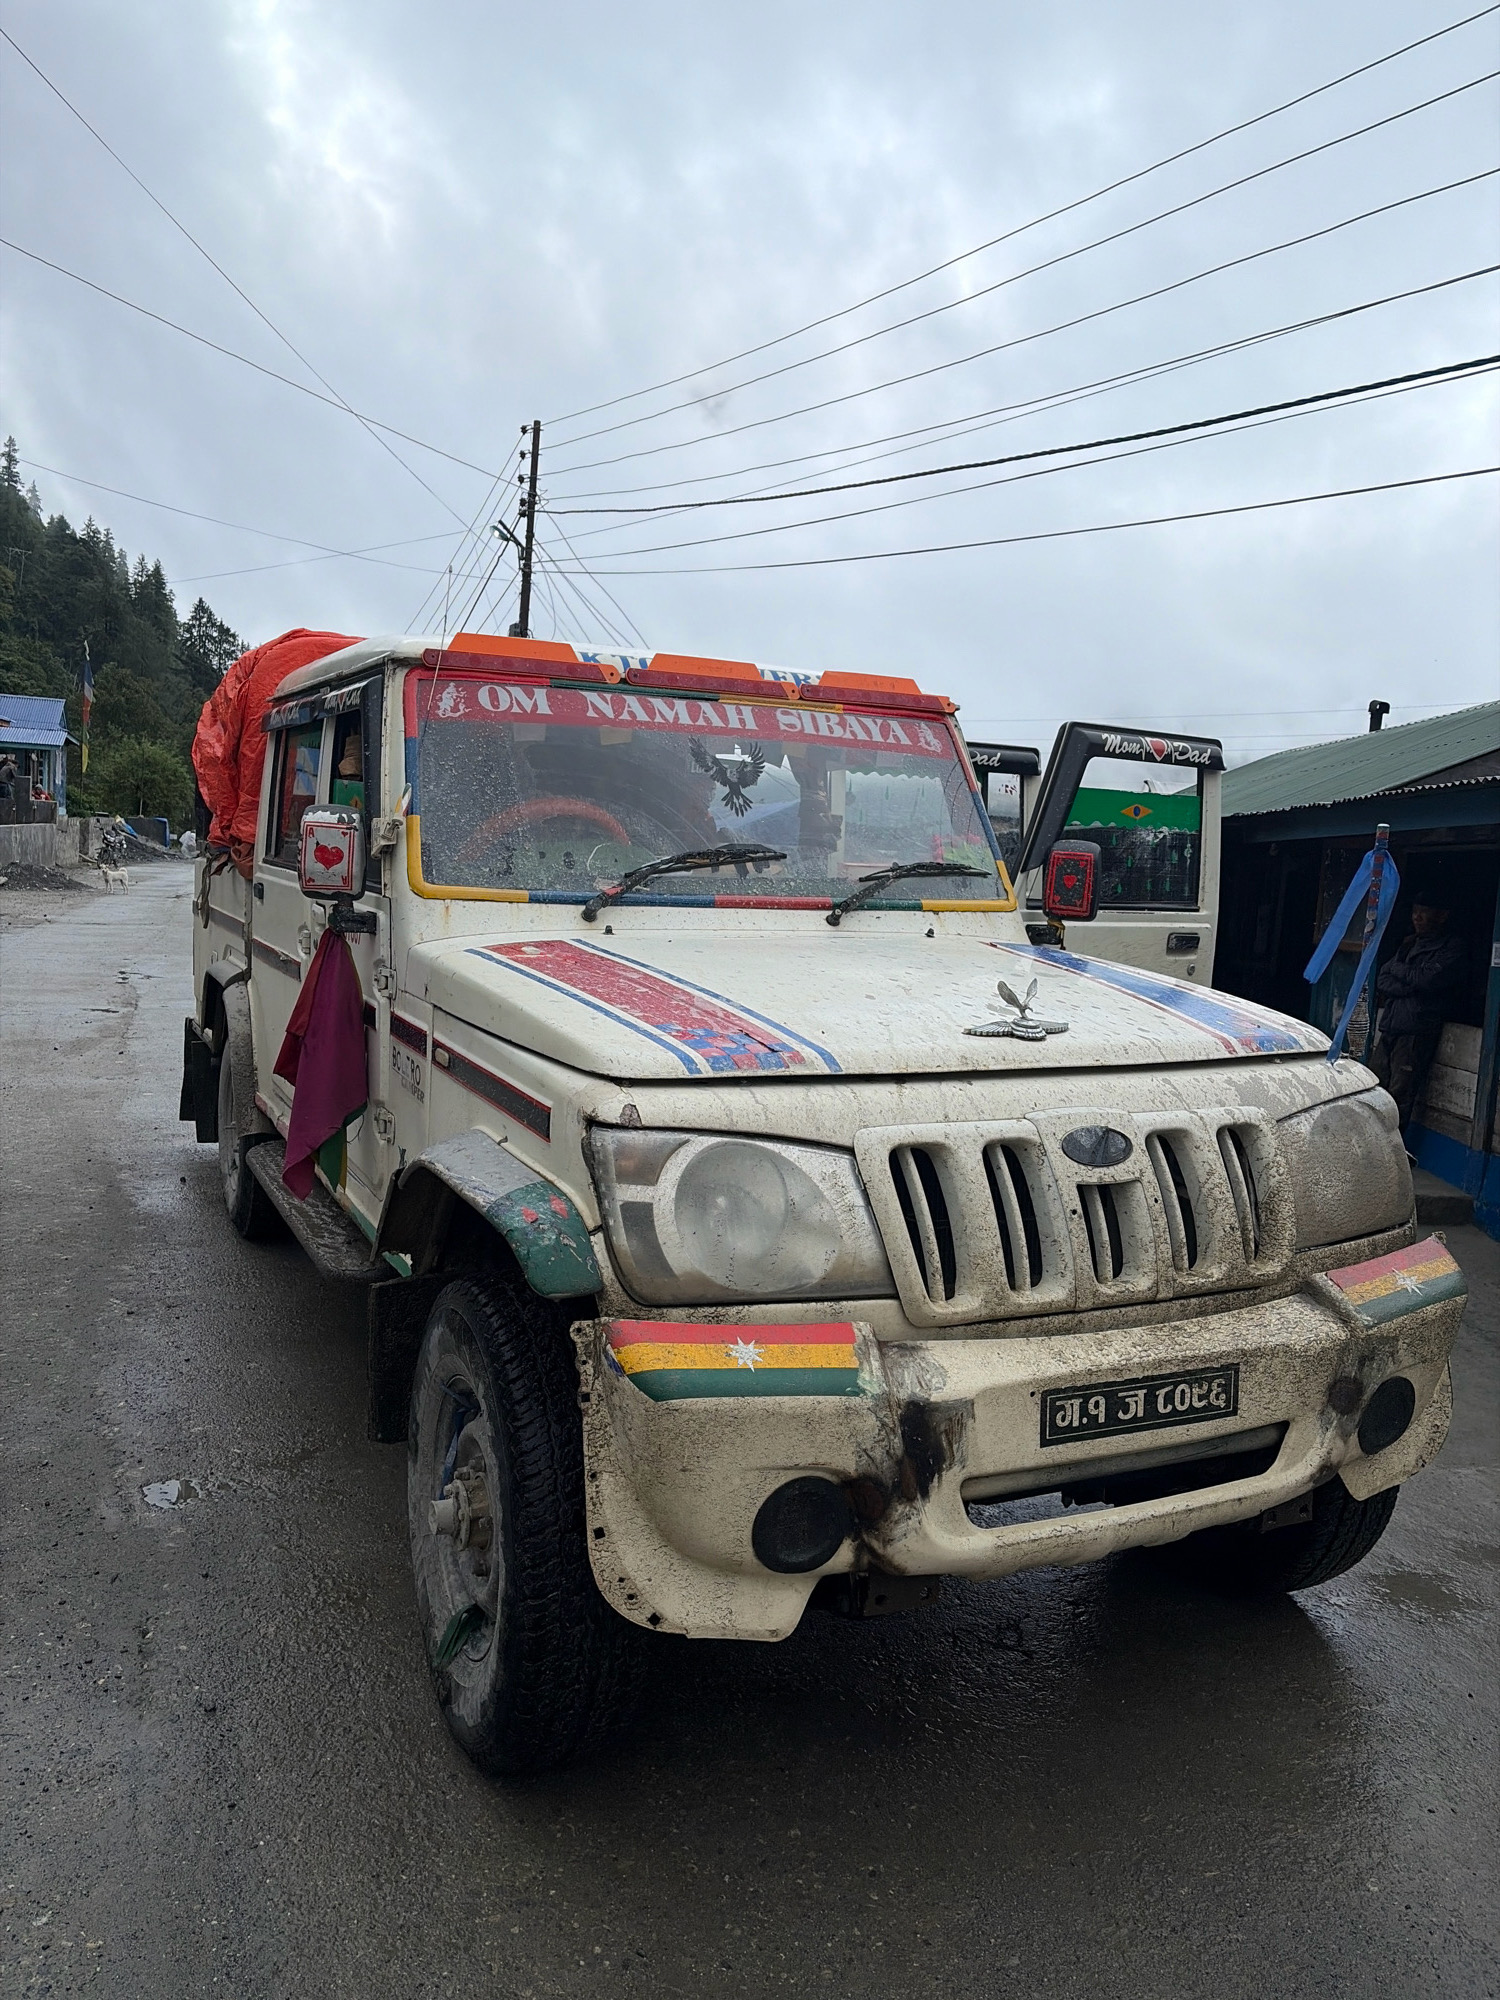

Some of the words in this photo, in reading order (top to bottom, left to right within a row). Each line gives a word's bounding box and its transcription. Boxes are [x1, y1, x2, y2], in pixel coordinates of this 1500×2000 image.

[477, 685, 553, 715] OM
[578, 690, 759, 730] NAMAH
[775, 708, 913, 746] SIBAYA
[1102, 733, 1144, 756] Mom
[1172, 742, 1211, 765] Dad
[392, 1045, 421, 1086] BORO
[1117, 1389, 1147, 1420] ज
